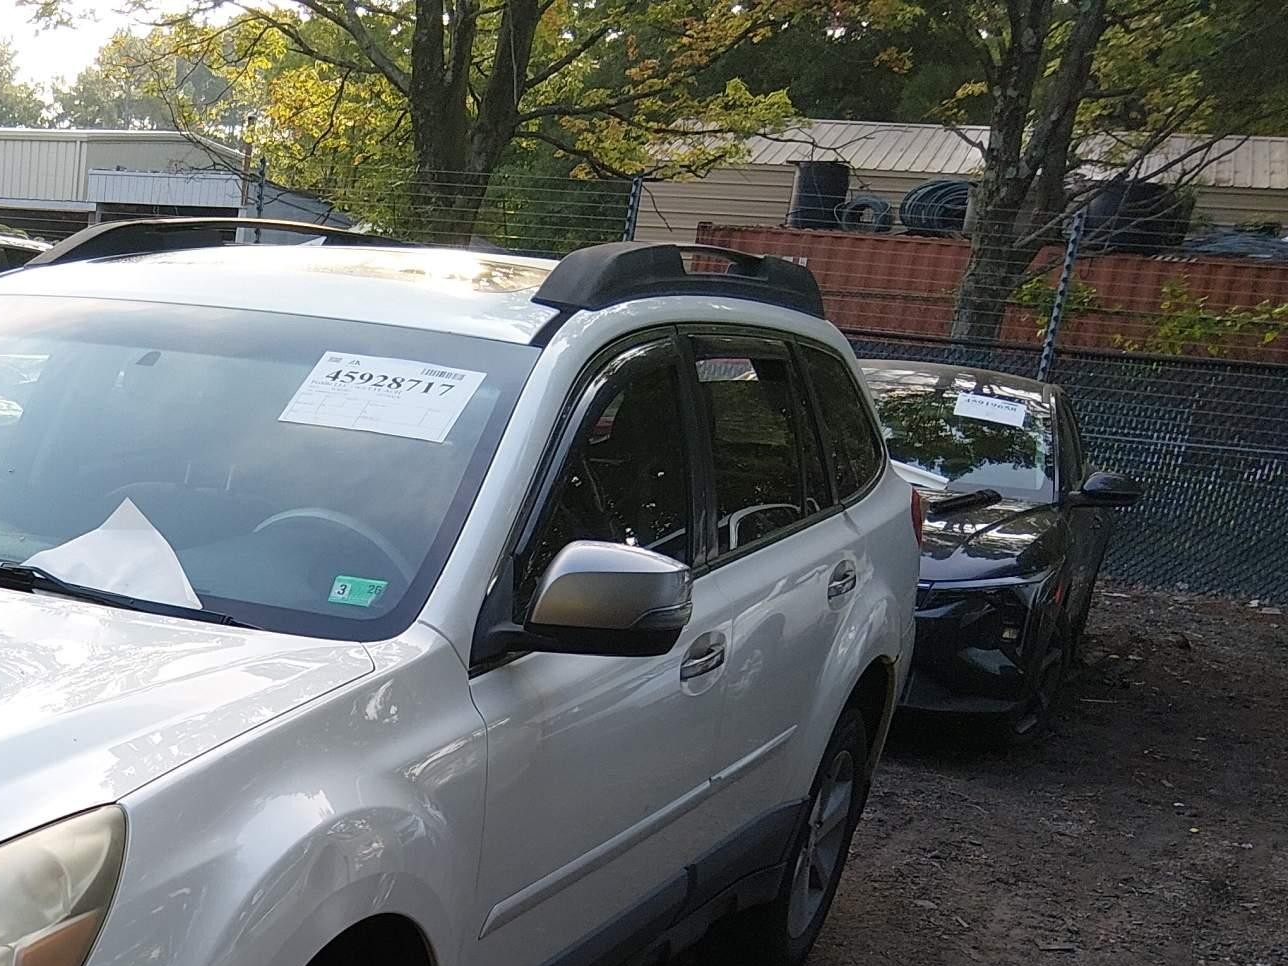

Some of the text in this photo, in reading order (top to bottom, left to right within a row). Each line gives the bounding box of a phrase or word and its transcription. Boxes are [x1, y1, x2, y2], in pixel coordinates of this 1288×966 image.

[325, 369, 456, 396] 45928717
[337, 583, 383, 596] 3 26
